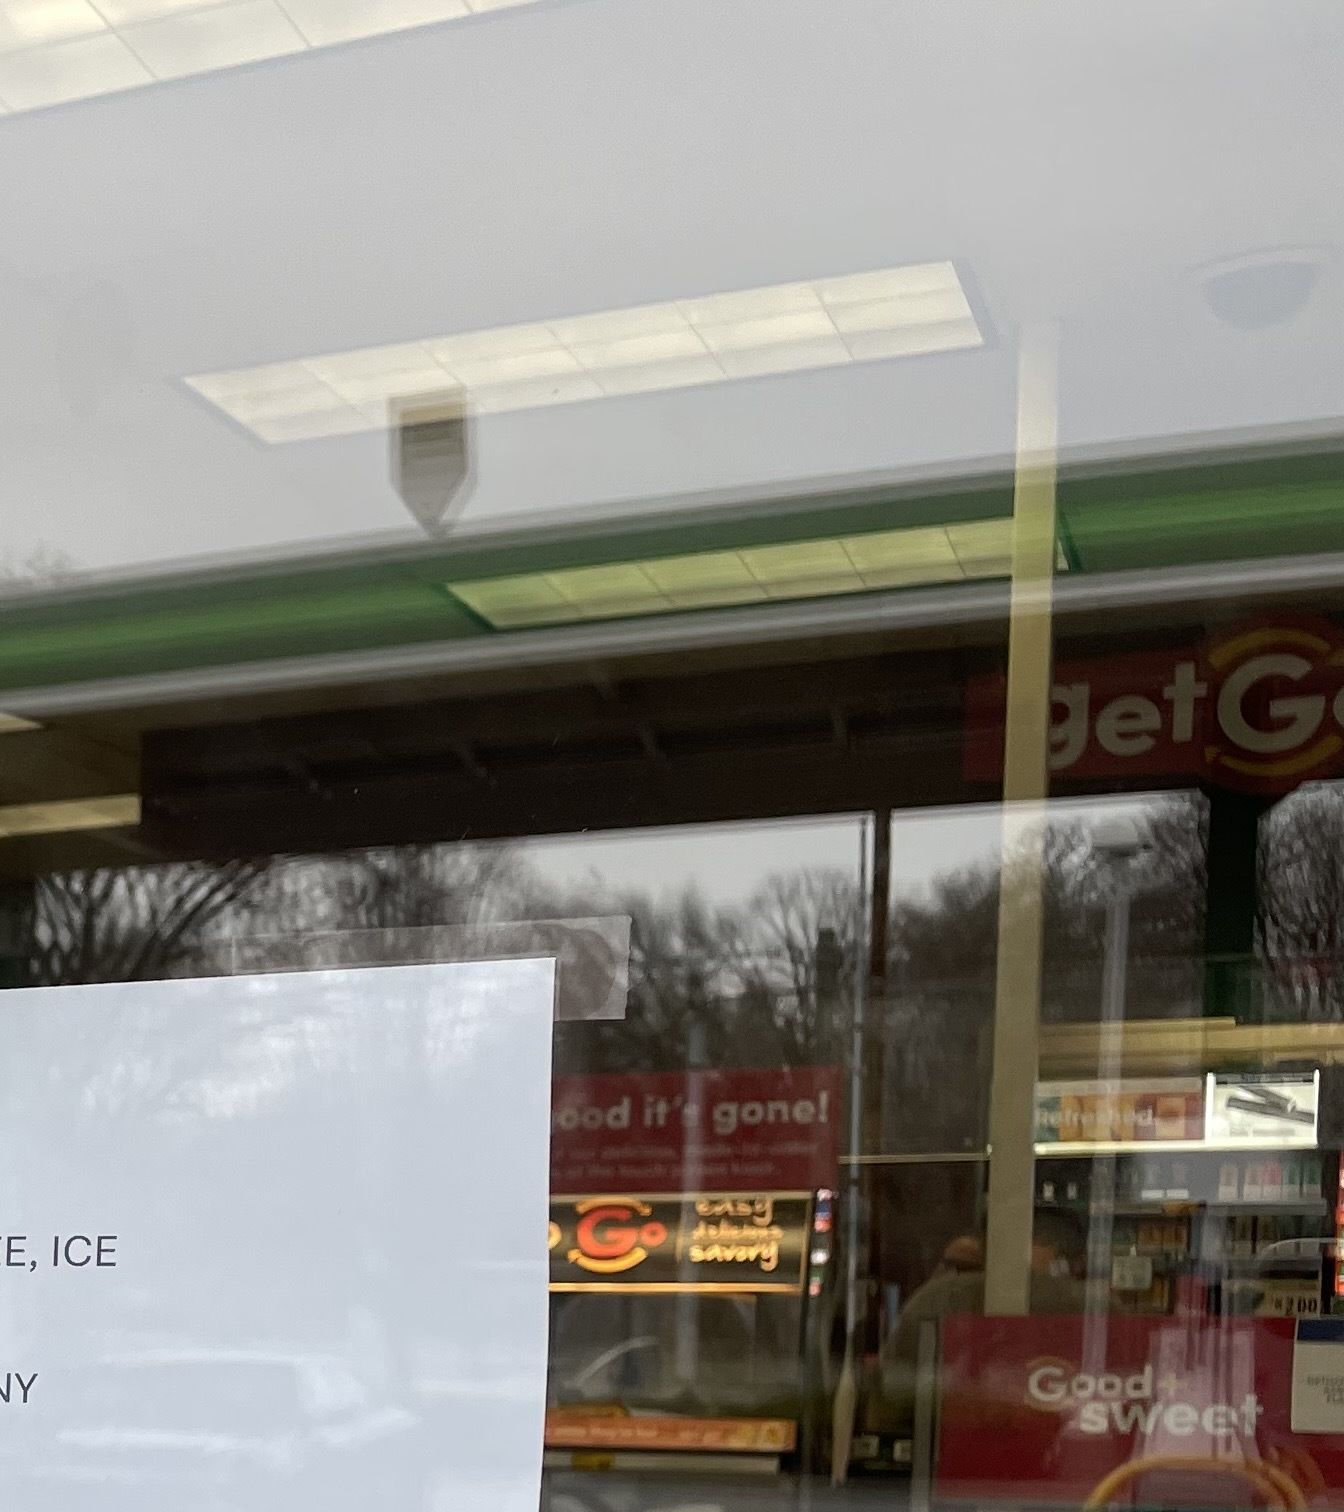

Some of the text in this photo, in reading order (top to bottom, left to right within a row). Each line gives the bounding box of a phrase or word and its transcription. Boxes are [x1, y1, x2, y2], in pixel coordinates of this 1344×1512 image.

[1047, 653, 1344, 770] getG
[555, 1096, 631, 1130] ood
[713, 1091, 828, 1135] gone!
[52, 1235, 118, 1267] ICE
[1077, 1394, 1262, 1438] sweet
